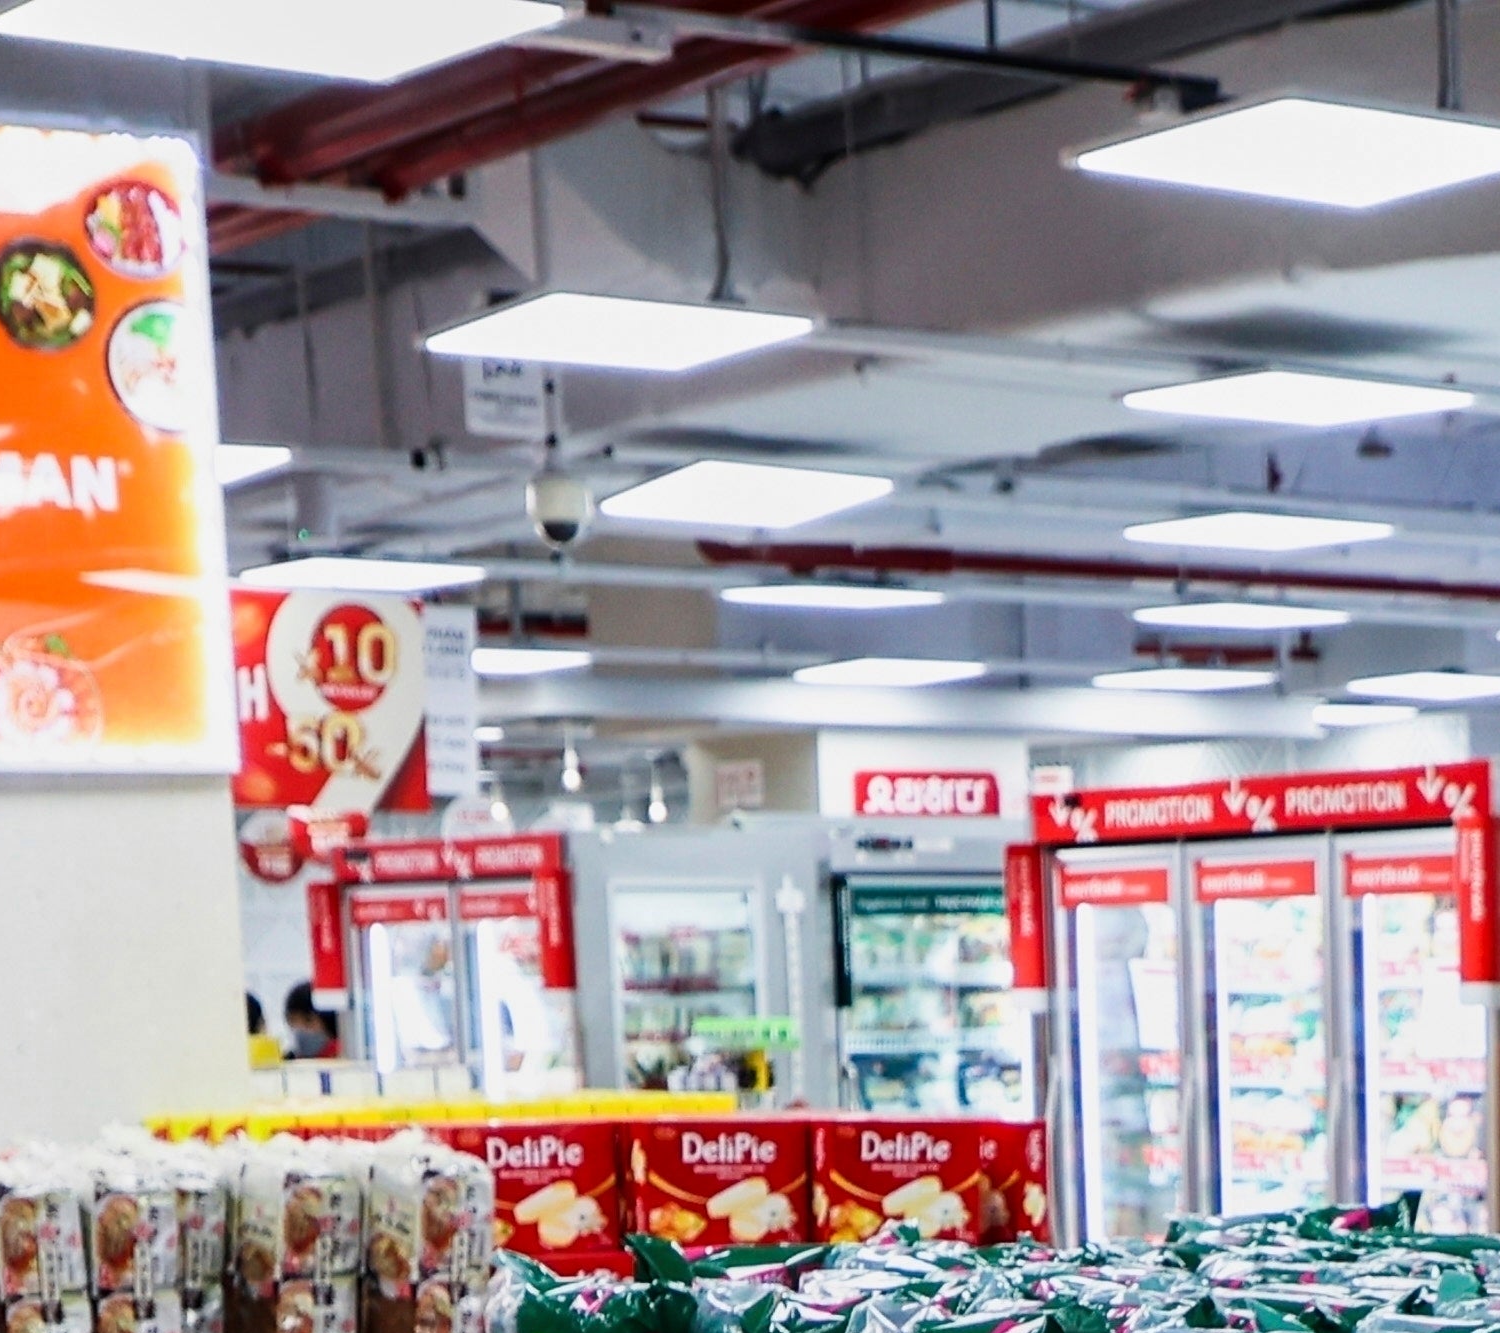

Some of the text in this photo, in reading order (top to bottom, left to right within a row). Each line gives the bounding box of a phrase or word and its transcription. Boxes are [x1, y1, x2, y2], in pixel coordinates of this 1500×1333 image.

[1104, 781, 1408, 829] PROMOTION PROMOTION
[485, 1137, 584, 1170] DeliPie
[680, 1131, 777, 1165] DeliPie
[860, 1130, 952, 1163] DeliPie
